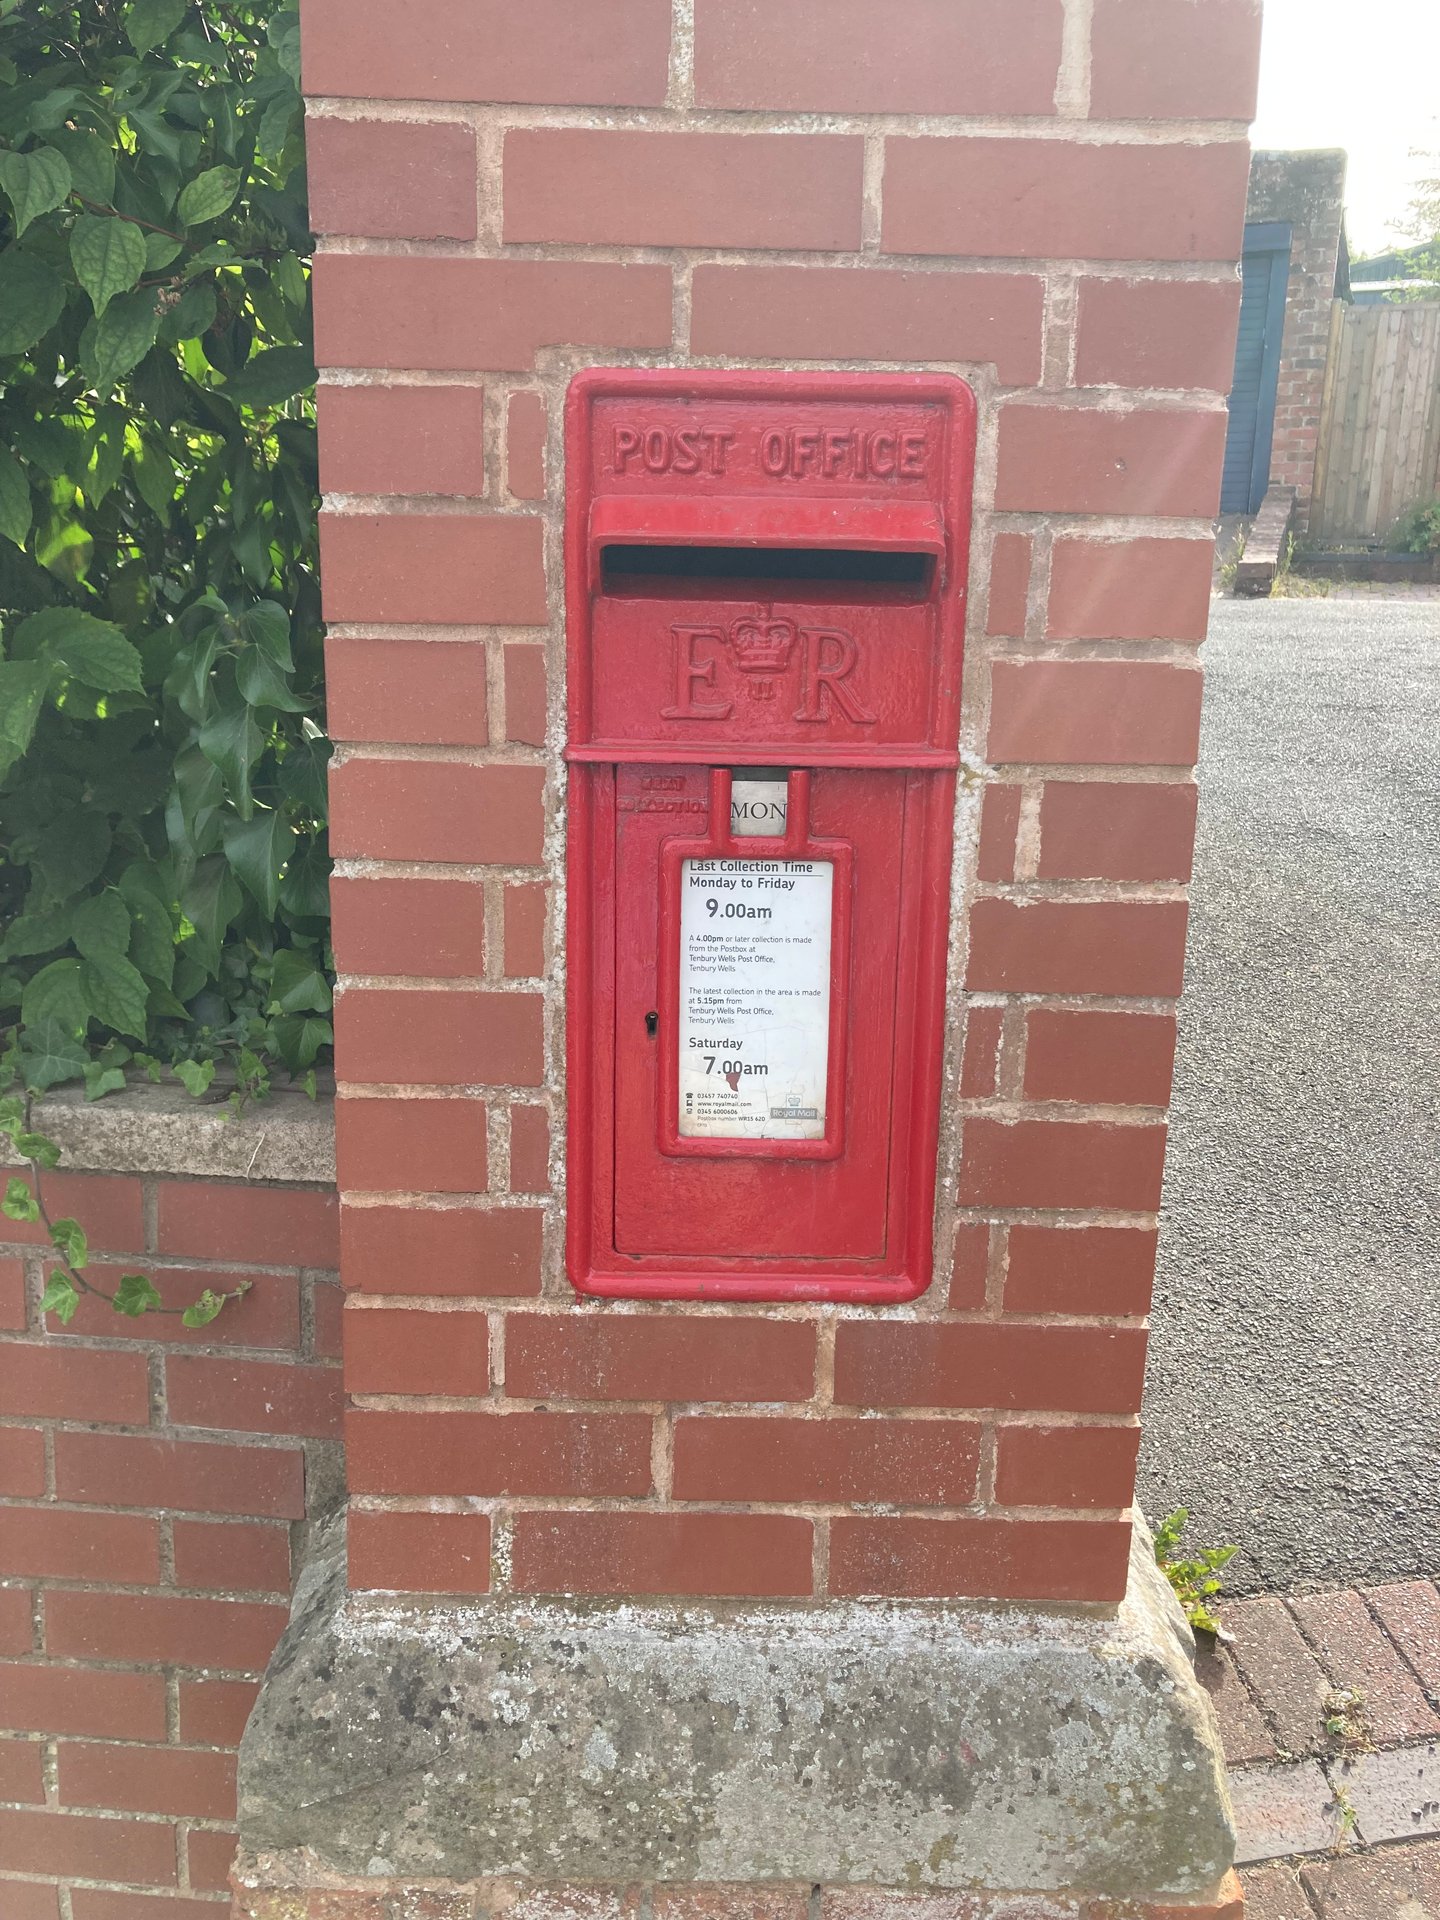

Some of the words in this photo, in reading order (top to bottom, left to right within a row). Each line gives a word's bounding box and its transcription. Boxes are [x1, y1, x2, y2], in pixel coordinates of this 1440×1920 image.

[612, 423, 734, 475] POST
[761, 427, 927, 480] OFFICE
[660, 623, 734, 721] E
[793, 626, 878, 724] R
[730, 802, 787, 819] MON
[690, 860, 716, 872] Last
[720, 860, 779, 872] Collection
[782, 861, 813, 873] Time
[689, 876, 737, 890] Monday
[741, 878, 753, 888] to
[758, 878, 795, 891] Friday
[705, 898, 772, 919] 9.00am
[696, 935, 724, 943] 4.00pm
[689, 954, 717, 963] Tenbury
[717, 954, 736, 962] Wells
[737, 955, 753, 963] Post
[754, 955, 776, 963] Office,
[689, 964, 717, 973] Tenbury
[717, 964, 736, 972] Wells
[703, 987, 722, 995] latest
[697, 998, 724, 1006] 5.15pm
[688, 1007, 716, 1016] Tenbury
[717, 1007, 735, 1015] Wells
[736, 1007, 752, 1015] Post
[753, 1008, 774, 1016] Office,
[688, 1016, 716, 1025] Tenbury
[689, 1037, 743, 1050] Saturday
[703, 1056, 769, 1075] 7.00am
[773, 1109, 796, 1117] Royal
[797, 1109, 816, 1117] Mail
